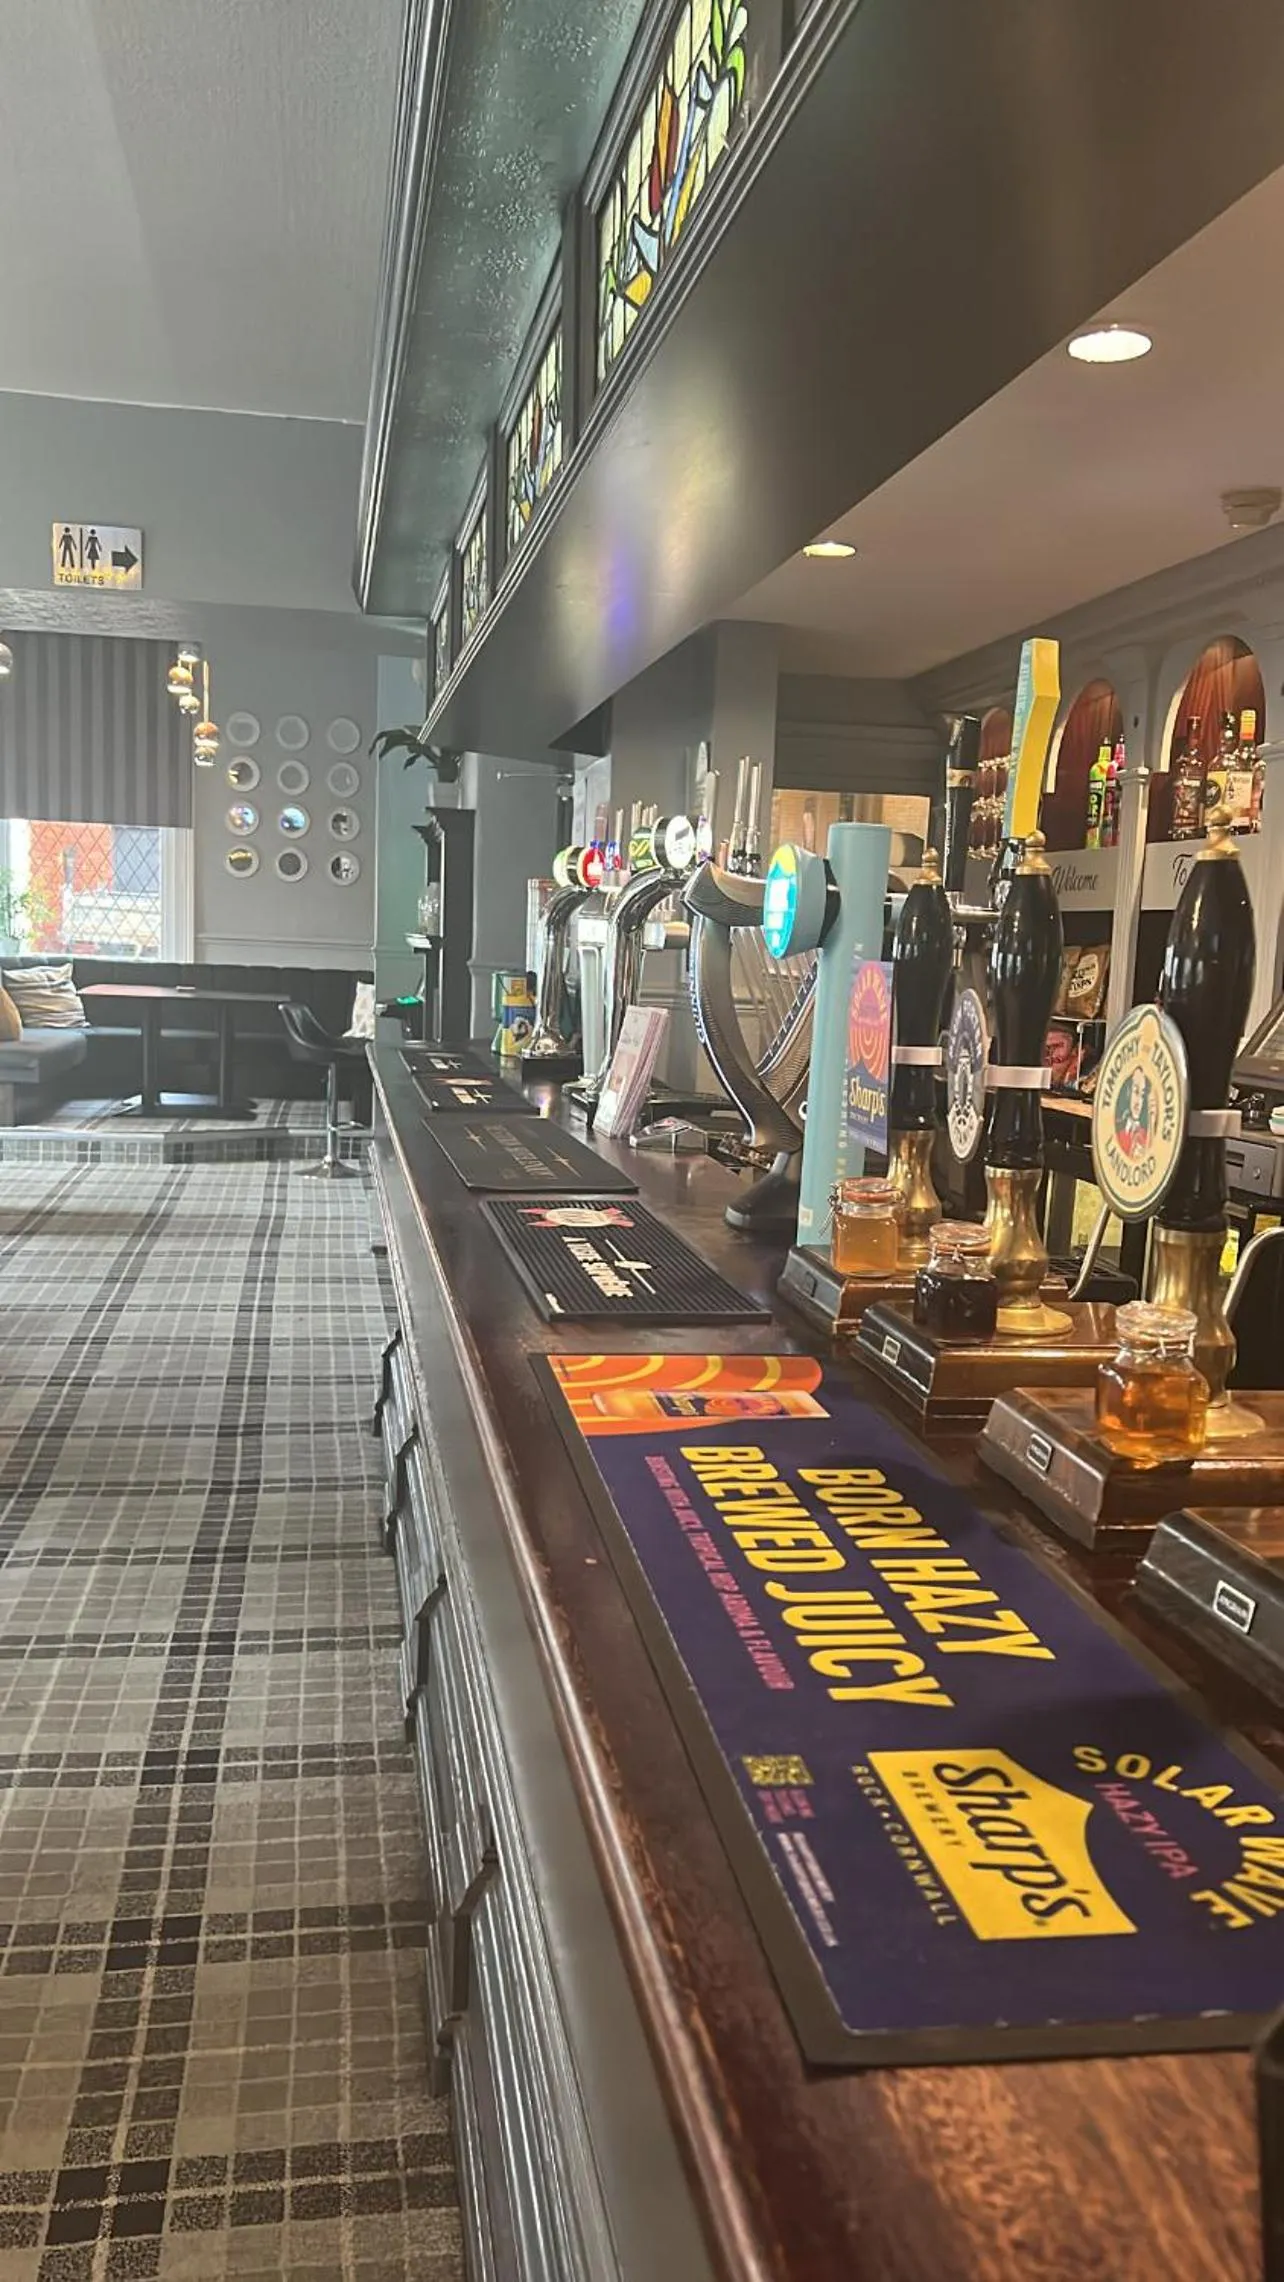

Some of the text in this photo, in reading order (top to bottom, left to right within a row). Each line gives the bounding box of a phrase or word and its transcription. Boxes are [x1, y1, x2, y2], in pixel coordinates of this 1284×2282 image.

[57, 573, 105, 585] TOILETS
[1052, 864, 1099, 894] Welcome
[849, 1075, 885, 1124] Sharp's
[1102, 1036, 1175, 1142] TIMOTHY TAYLOR'S
[1105, 1135, 1156, 1187] LANDLORD
[680, 1446, 953, 1707] BREWED JUICY
[797, 1467, 1054, 1660] BORN HAZY
[719, 1593, 760, 1627] AROMA
[744, 1640, 795, 1690] FLAVOUR
[852, 1765, 958, 1926] ROCK CORNWALL
[902, 1771, 963, 1847] BREWERY
[932, 1763, 1091, 1918] Sharp's
[1072, 1745, 1284, 1928] SOLAR WAVE
[1095, 1783, 1199, 1879] HAZY IPA
